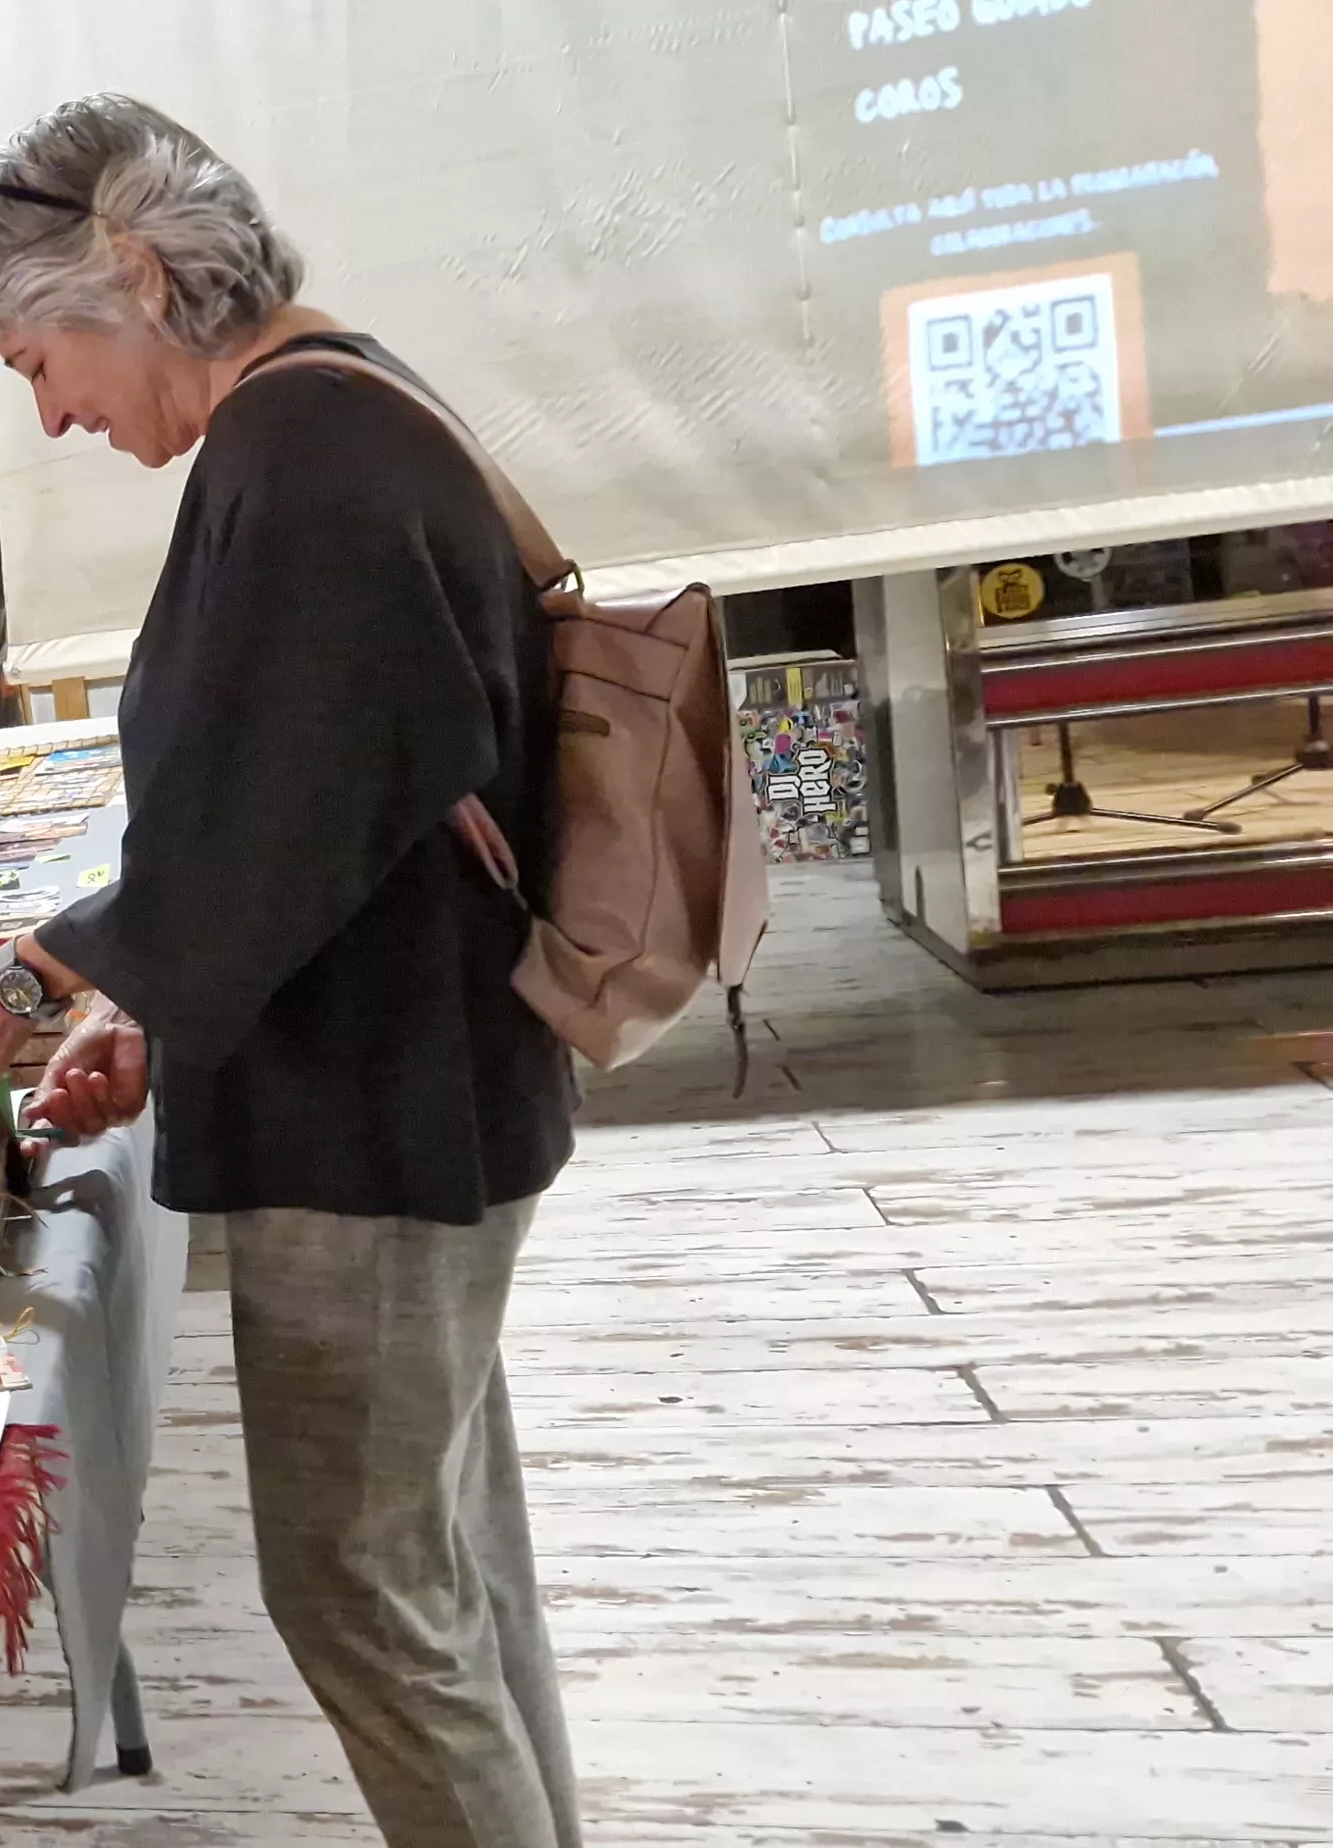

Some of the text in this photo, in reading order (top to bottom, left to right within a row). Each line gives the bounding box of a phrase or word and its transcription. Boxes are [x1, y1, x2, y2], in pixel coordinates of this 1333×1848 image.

[848, 0, 961, 50] PASEO
[854, 66, 963, 123] COROS
[768, 774, 802, 801] DJ
